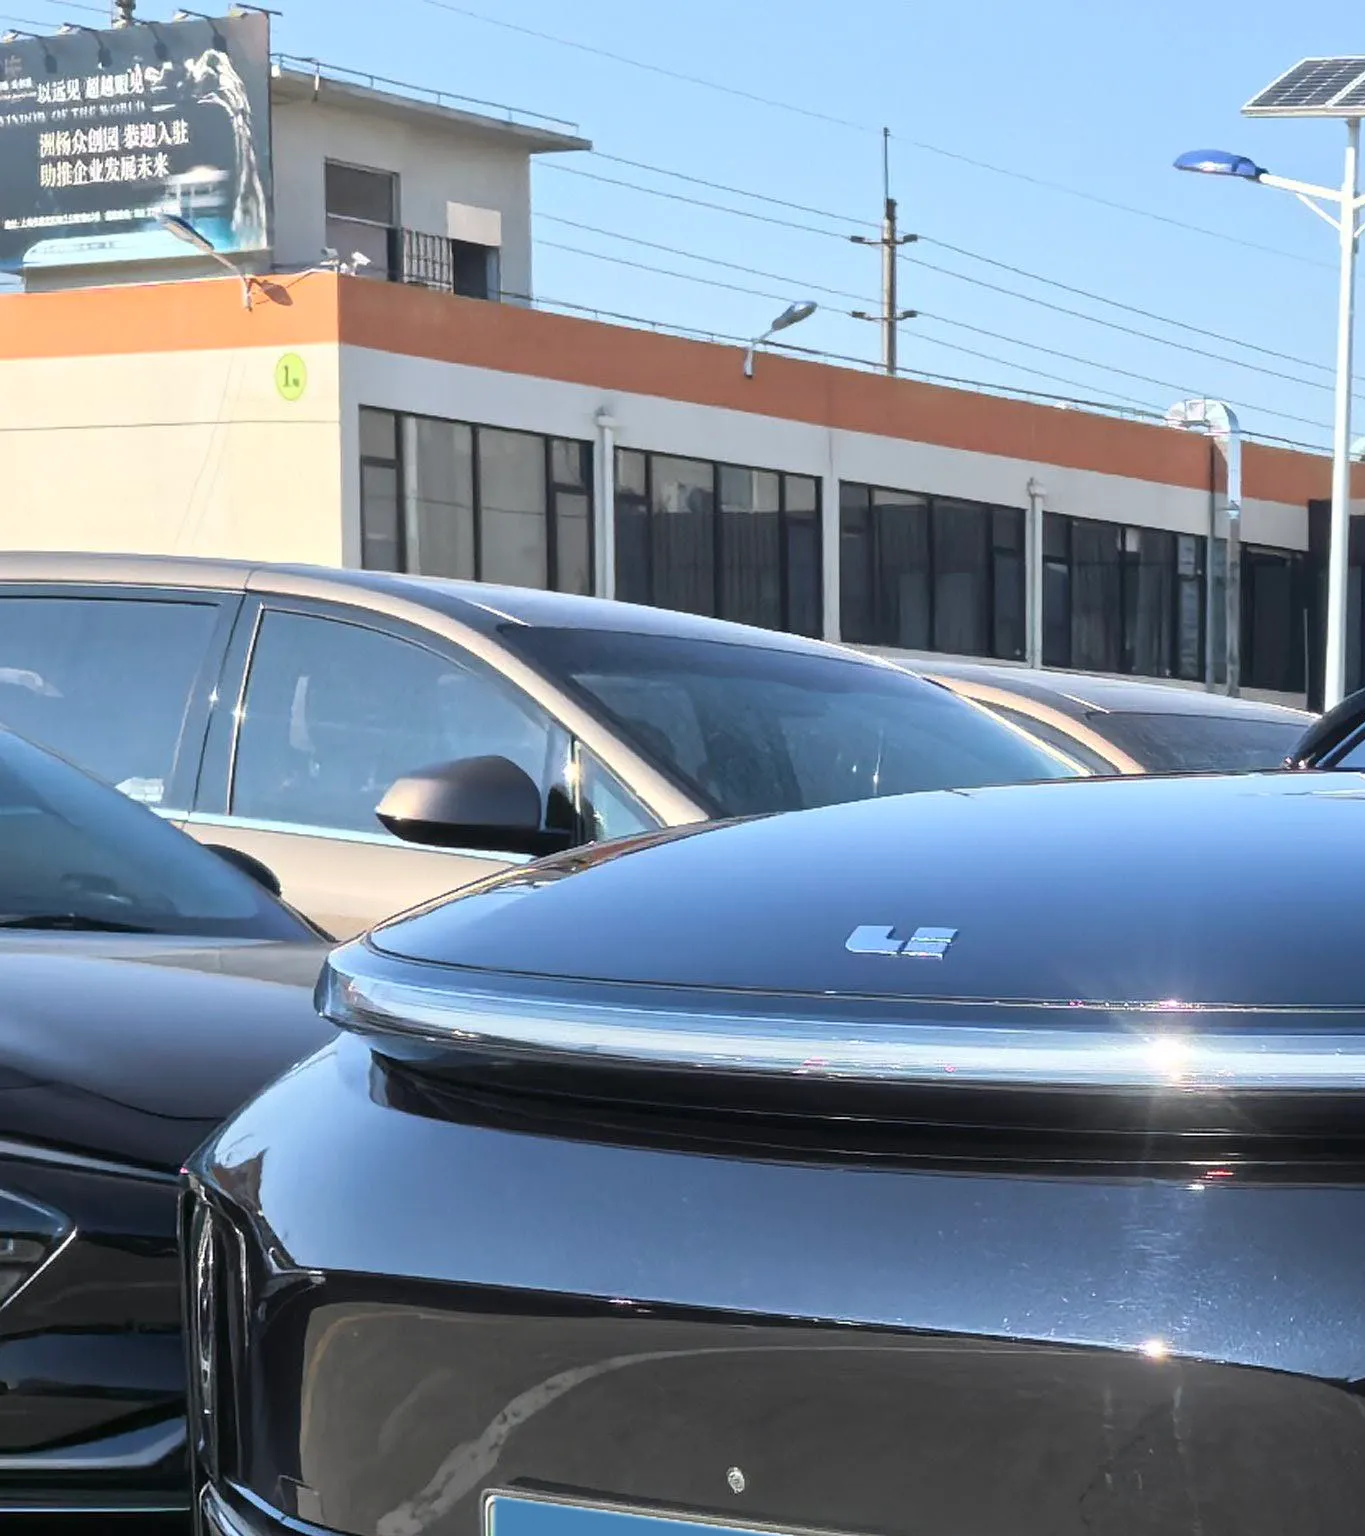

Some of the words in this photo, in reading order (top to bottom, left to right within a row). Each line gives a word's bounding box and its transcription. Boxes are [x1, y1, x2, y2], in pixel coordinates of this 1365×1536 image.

[51, 108, 67, 122] OF
[71, 105, 96, 119] THE
[123, 118, 189, 150] 恭迎入驻
[40, 152, 170, 188] 助推企业发展未来
